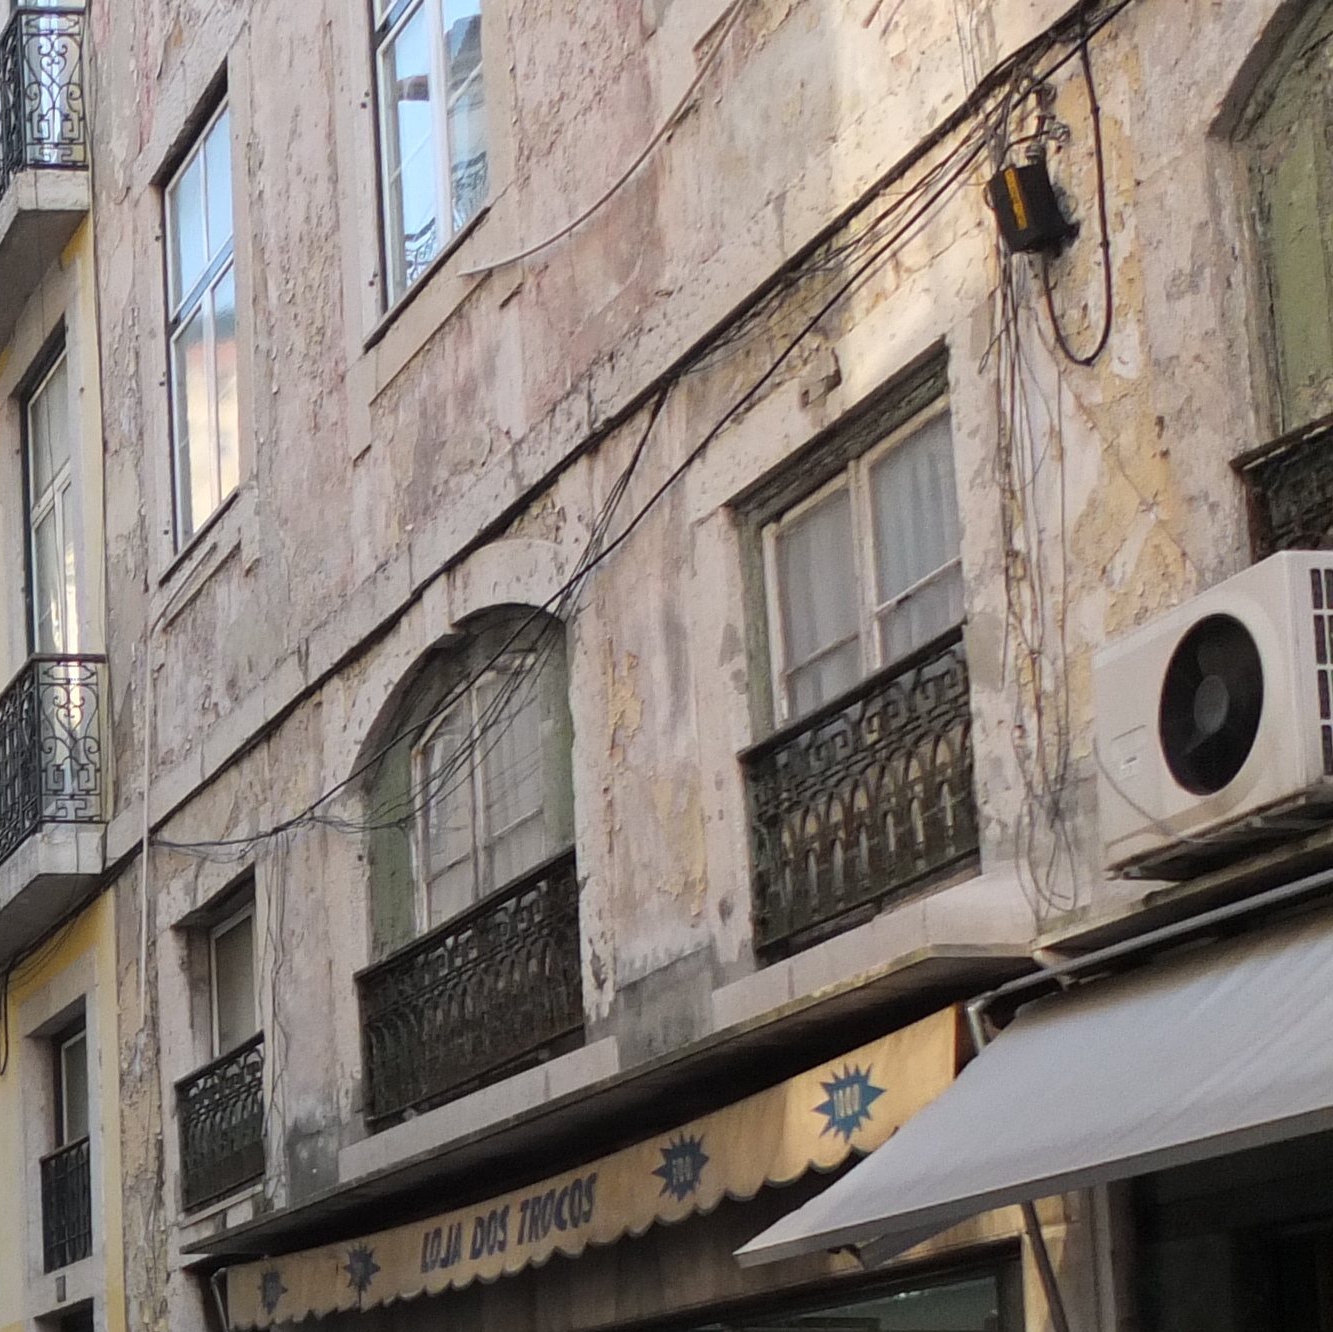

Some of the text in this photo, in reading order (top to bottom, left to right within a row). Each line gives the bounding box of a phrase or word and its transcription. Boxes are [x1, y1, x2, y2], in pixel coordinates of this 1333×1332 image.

[420, 1172, 599, 1274] LOJA DOS TROCOS
